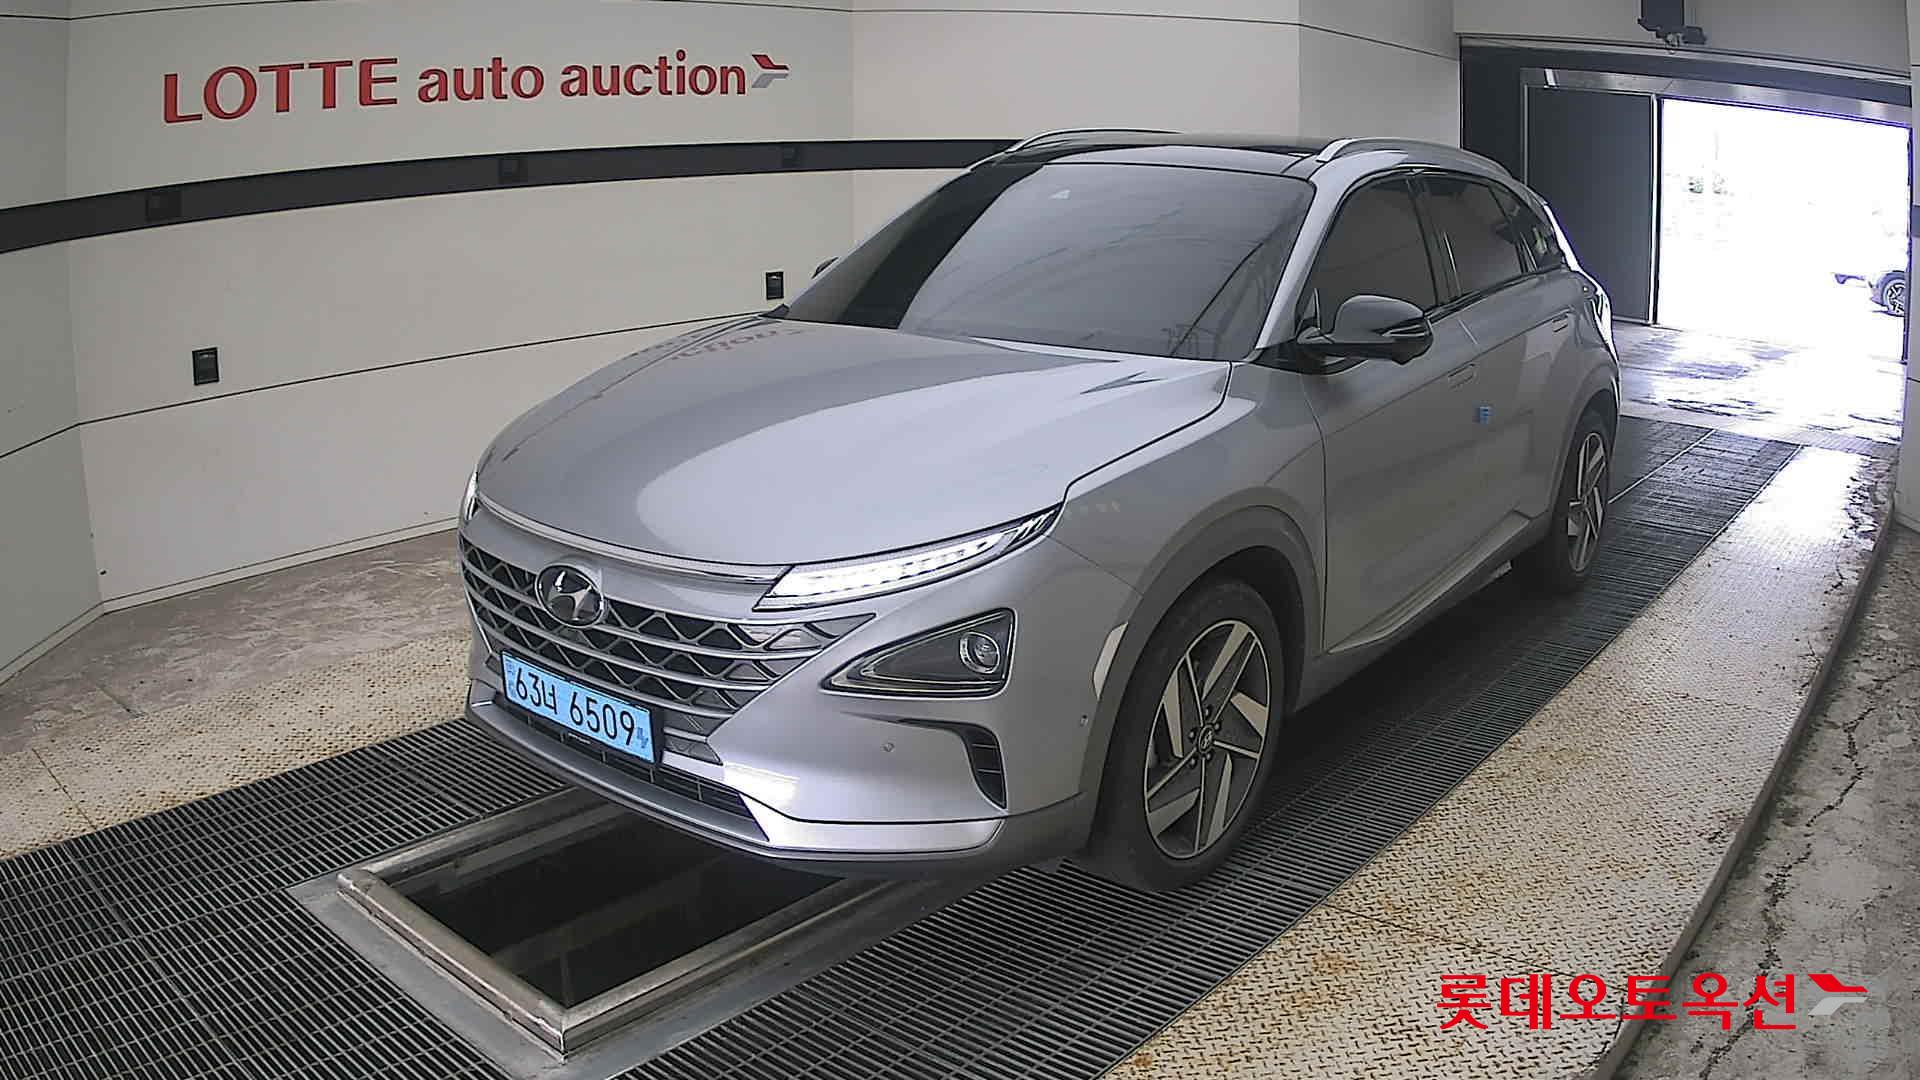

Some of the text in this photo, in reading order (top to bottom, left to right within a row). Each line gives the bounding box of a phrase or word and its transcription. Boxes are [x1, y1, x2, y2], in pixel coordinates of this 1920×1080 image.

[164, 49, 747, 124] LOTTE auto auction
[515, 667, 635, 746] 63너 6509
